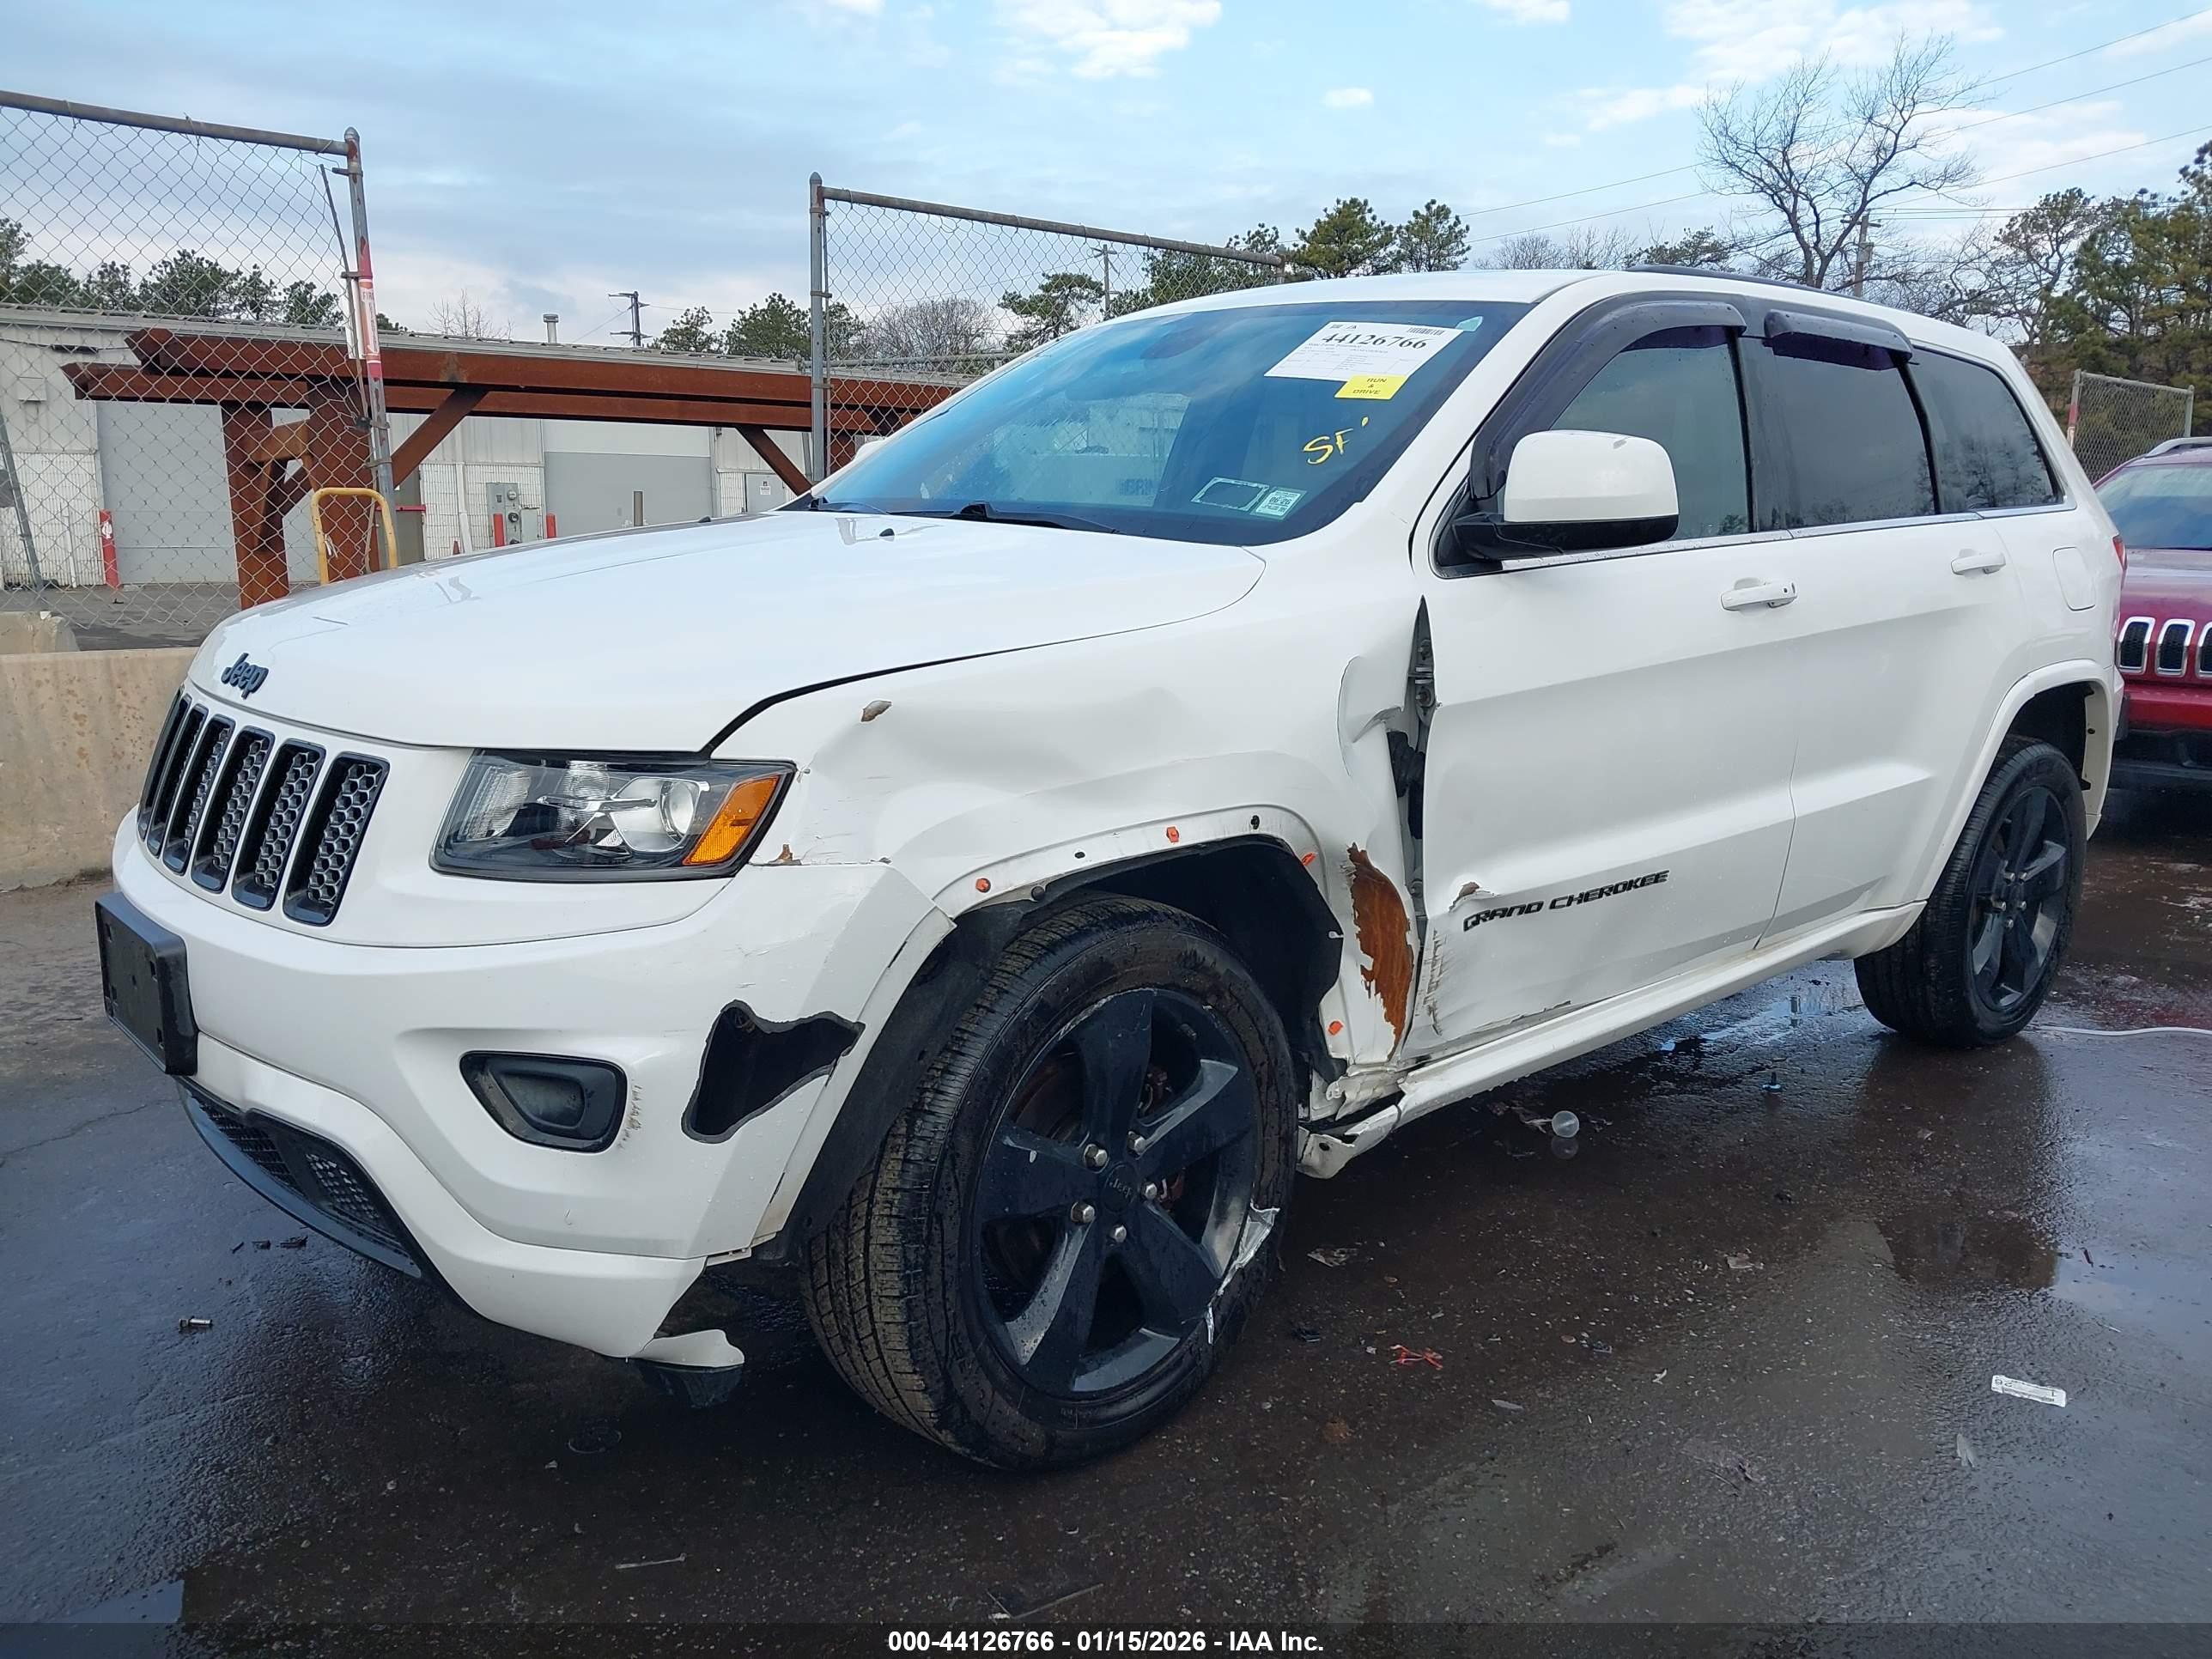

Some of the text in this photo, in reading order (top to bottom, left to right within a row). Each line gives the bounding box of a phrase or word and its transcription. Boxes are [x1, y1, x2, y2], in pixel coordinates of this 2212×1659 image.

[1322, 332, 1431, 349] 44126766
[221, 652, 270, 700] Jeep
[1462, 869, 1670, 932] GRAND CHEROKEE
